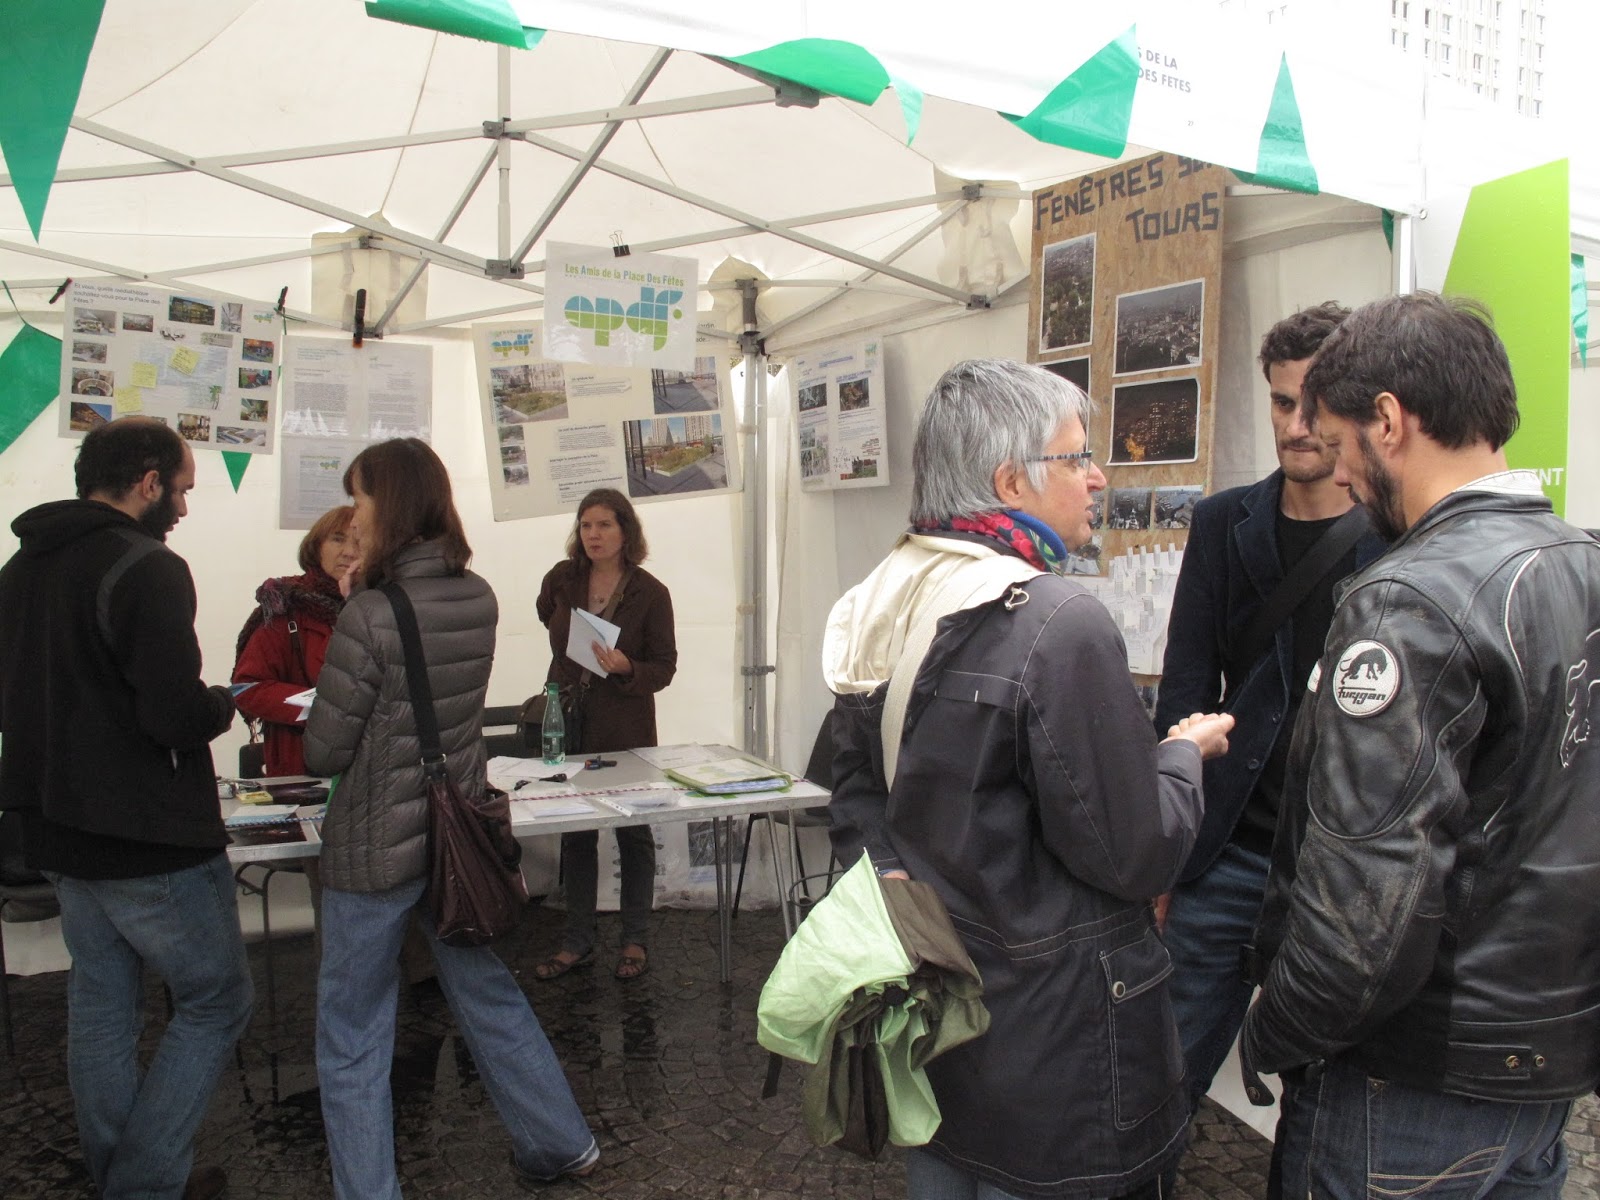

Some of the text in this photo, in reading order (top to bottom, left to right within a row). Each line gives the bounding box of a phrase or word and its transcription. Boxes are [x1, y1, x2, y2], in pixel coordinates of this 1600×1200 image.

[1146, 49, 1160, 64] DE
[1164, 55, 1178, 70] LA
[1161, 74, 1191, 93] FETES
[1035, 156, 1164, 231] FENÊTRES
[1125, 191, 1220, 243] TOURS
[565, 263, 579, 275] Les
[581, 265, 600, 277] Amis
[602, 268, 612, 278] de
[614, 269, 621, 279] la
[623, 270, 645, 282] Place
[647, 273, 661, 284] Des
[663, 274, 685, 287] Fêtes
[1337, 686, 1387, 705] furygan
